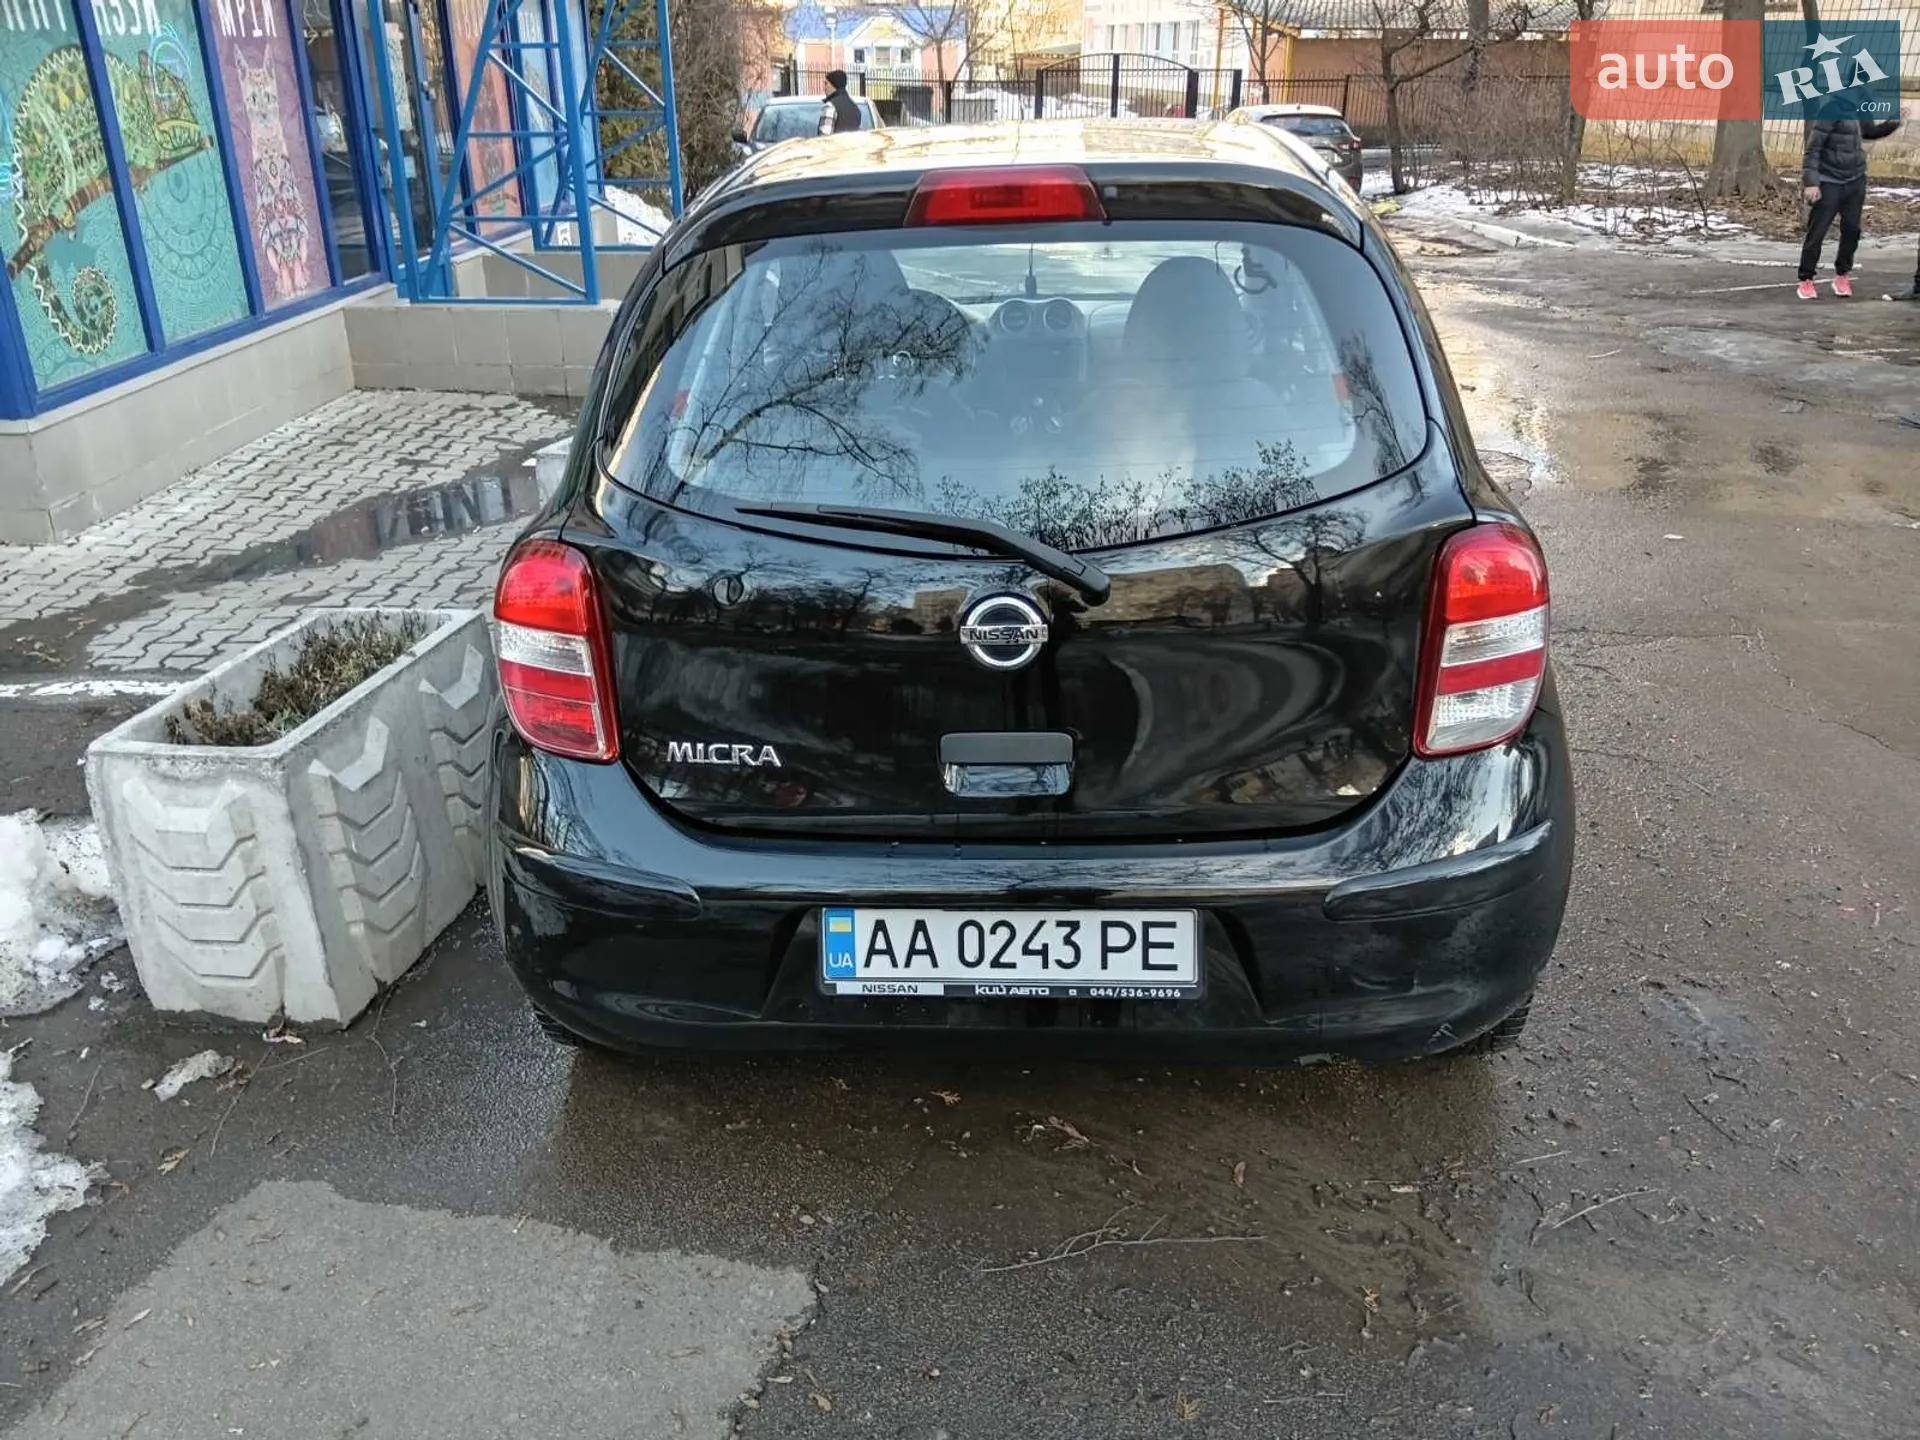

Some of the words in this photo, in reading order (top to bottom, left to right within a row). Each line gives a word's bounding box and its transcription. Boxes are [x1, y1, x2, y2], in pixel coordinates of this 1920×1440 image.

[968, 628, 1039, 641] NISSAN
[666, 741, 782, 767] MICRA
[863, 919, 939, 969] AA
[957, 919, 1081, 970] 0243
[1100, 920, 1178, 971] PE
[828, 952, 853, 968] UA
[862, 983, 918, 994] NISSAN
